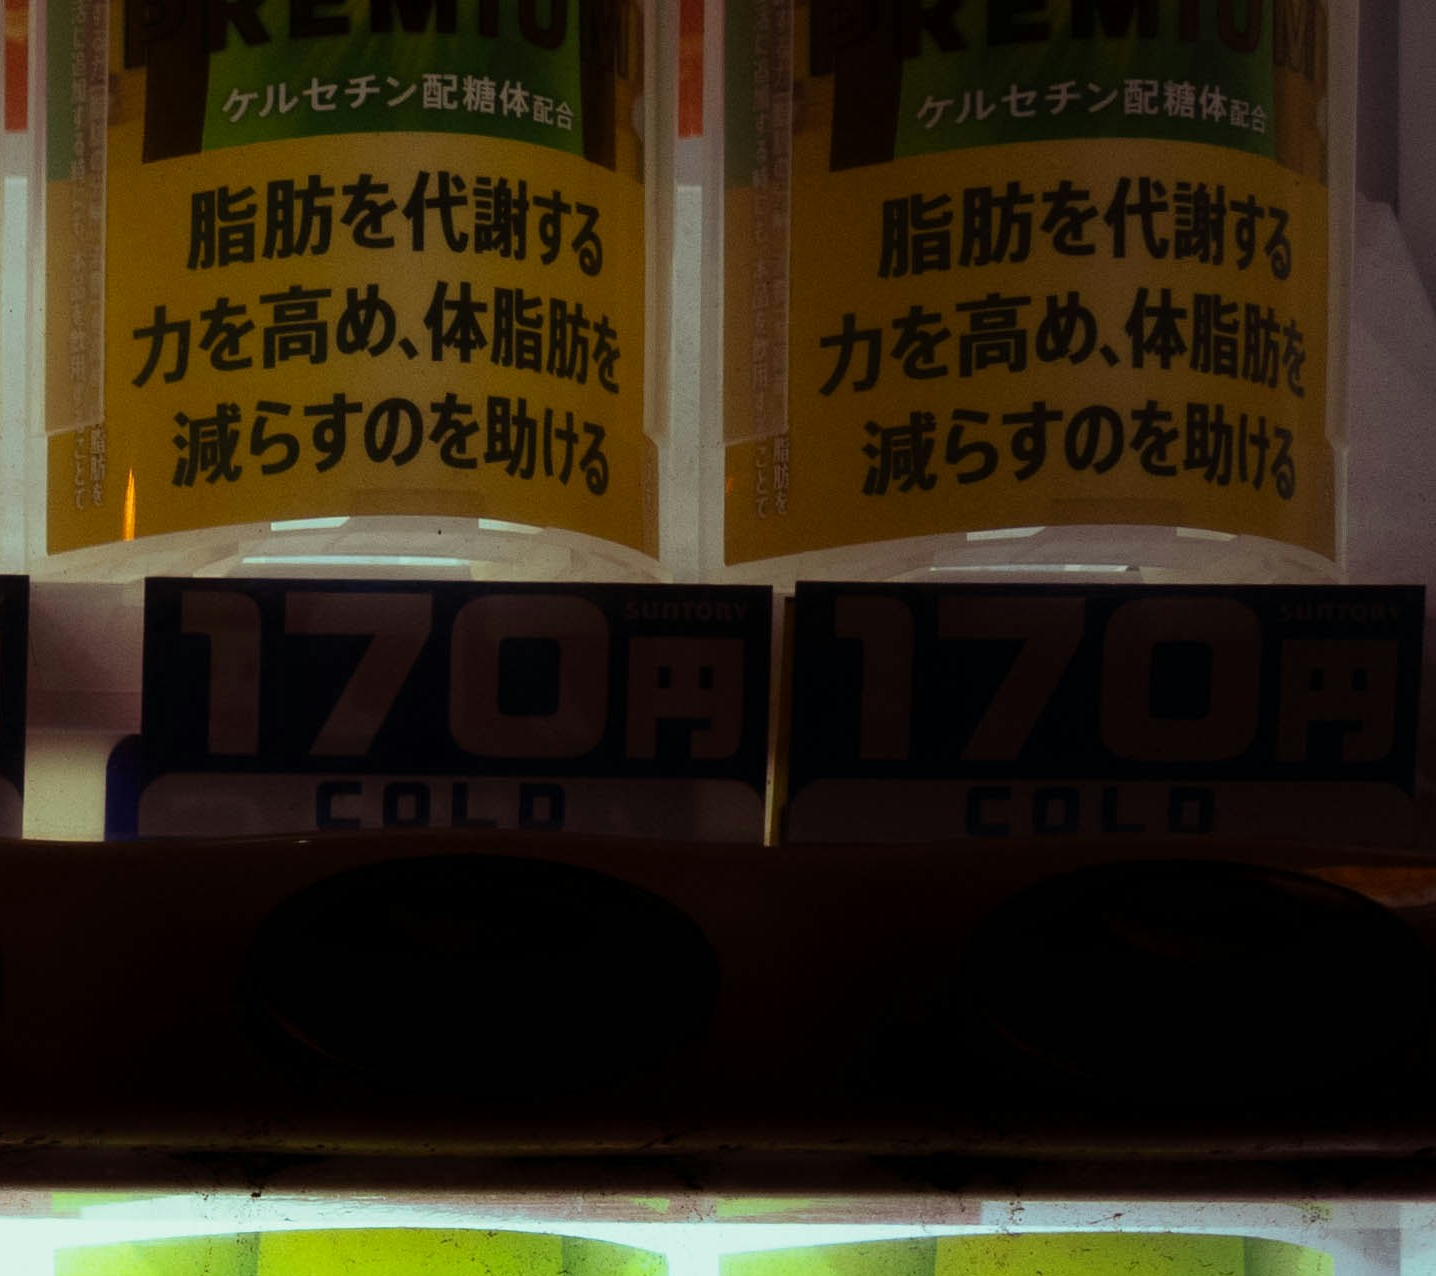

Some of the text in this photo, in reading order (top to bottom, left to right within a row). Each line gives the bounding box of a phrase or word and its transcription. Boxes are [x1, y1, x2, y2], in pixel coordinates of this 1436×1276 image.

[222, 74, 574, 130] ケルセチン配糖体配合
[916, 79, 1268, 133] ケルセチン配糖体配合
[187, 171, 603, 276] 脂肪を代謝する
[878, 176, 1292, 280] 脂肪を代謝する
[133, 280, 619, 394] 力を高め、体脂肪を
[819, 287, 1305, 398] 力を高め、体脂肪を
[171, 391, 608, 495] 減らすのを助ける
[862, 400, 1294, 500] 減らすのを助ける
[316, 782, 565, 832] COLD
[966, 787, 1217, 837] COLD
